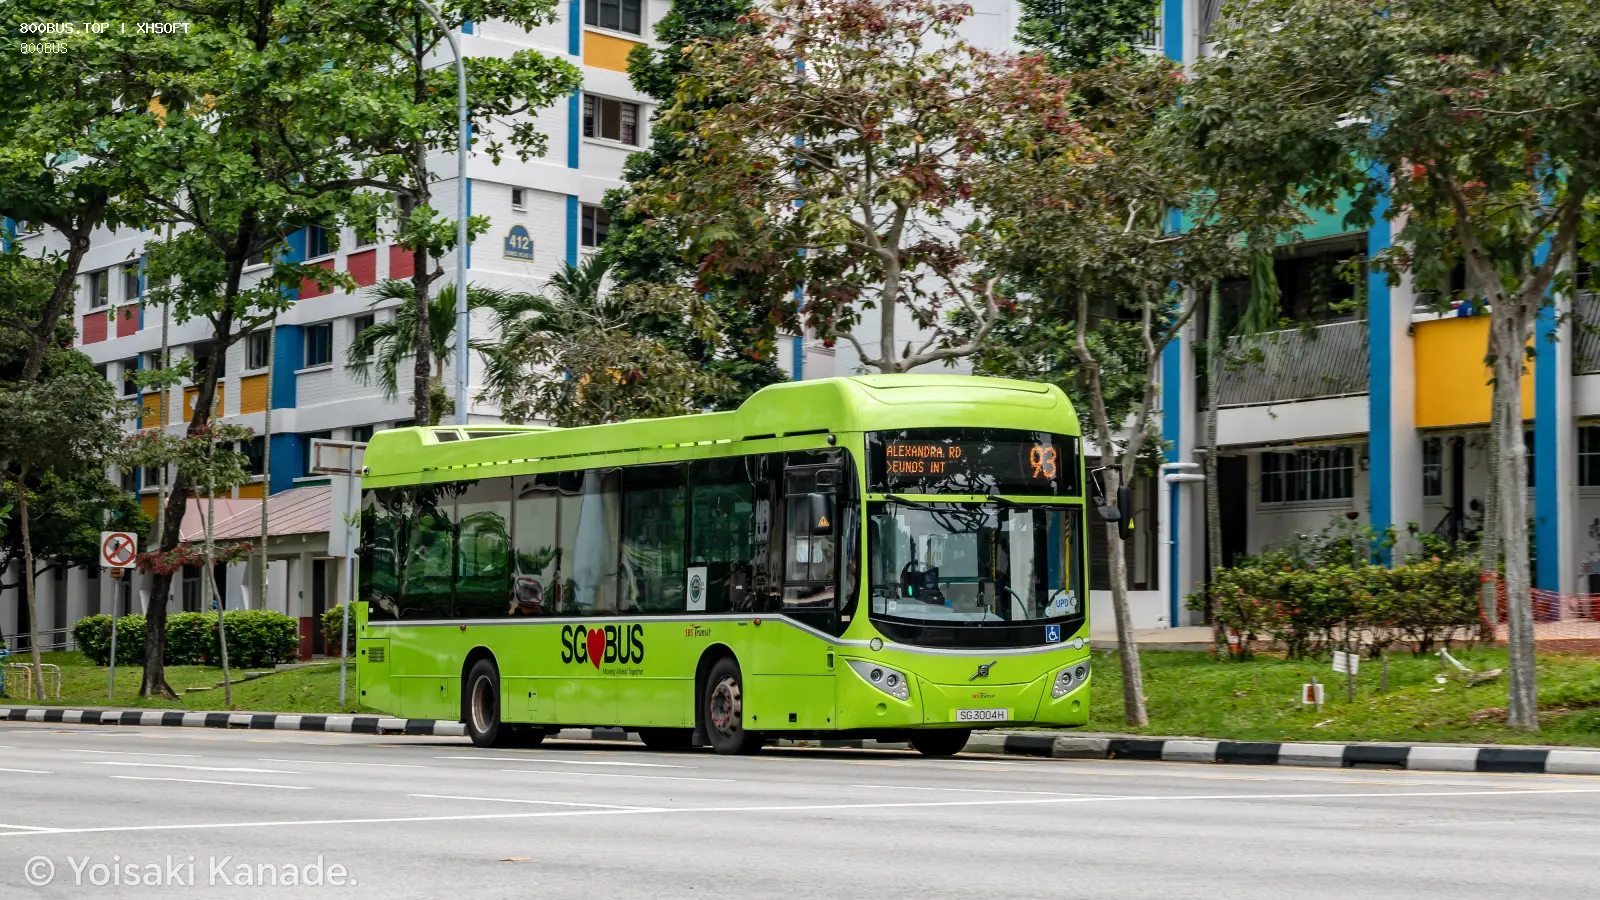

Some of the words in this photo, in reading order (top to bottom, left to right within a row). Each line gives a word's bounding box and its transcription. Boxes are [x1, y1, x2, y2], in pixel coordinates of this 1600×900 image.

[509, 234, 530, 250] 412
[886, 445, 943, 458] ALEXANDRA
[948, 446, 962, 459] RD
[930, 461, 946, 474] INT
[1029, 446, 1058, 479] 93
[1056, 598, 1069, 608] UPD
[561, 624, 588, 664] SG
[604, 623, 645, 664] BUS
[960, 710, 1005, 720] SG3004H
